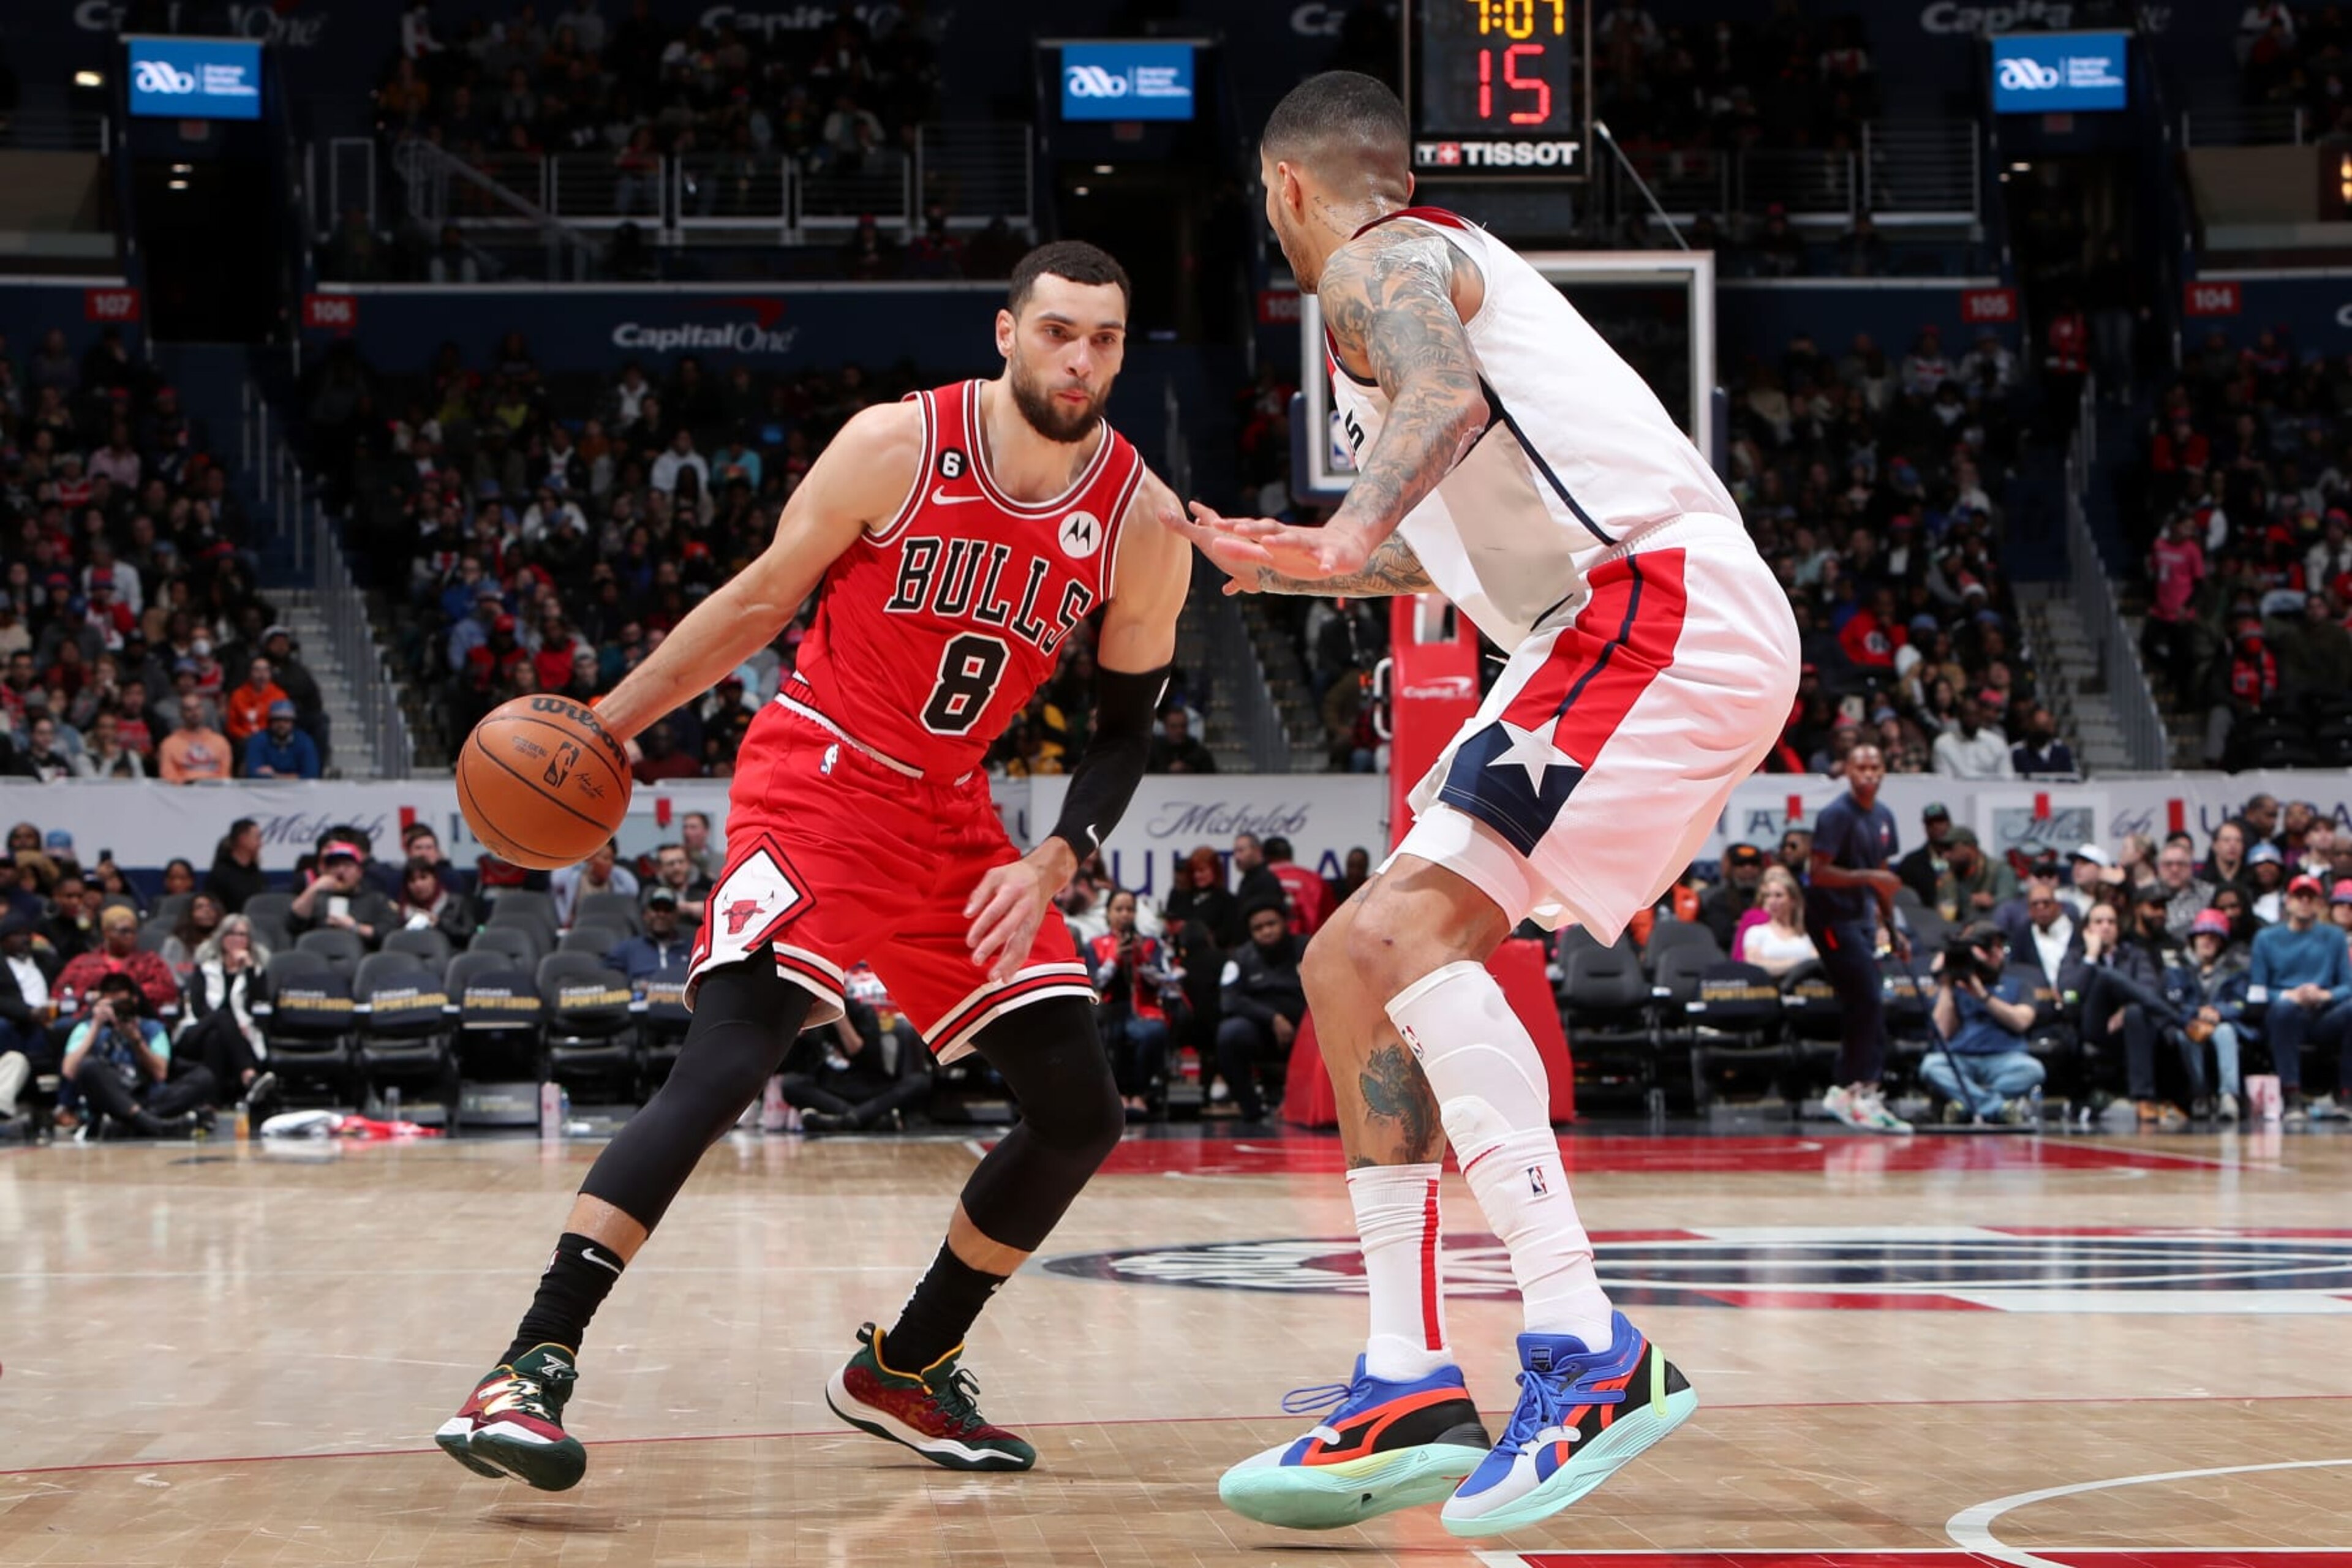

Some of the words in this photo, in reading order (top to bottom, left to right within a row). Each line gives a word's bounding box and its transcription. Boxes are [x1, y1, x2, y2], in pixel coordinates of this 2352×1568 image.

[1479, 43, 1551, 124] 15
[1461, 142, 1580, 166] TISSOT
[94, 295, 133, 314] 107
[312, 300, 351, 322] 106
[1970, 295, 2009, 317] 105
[941, 451, 961, 478] 6
[883, 535, 1095, 657] BULLS
[919, 630, 1011, 736] 8
[1146, 799, 1311, 839] Michelob
